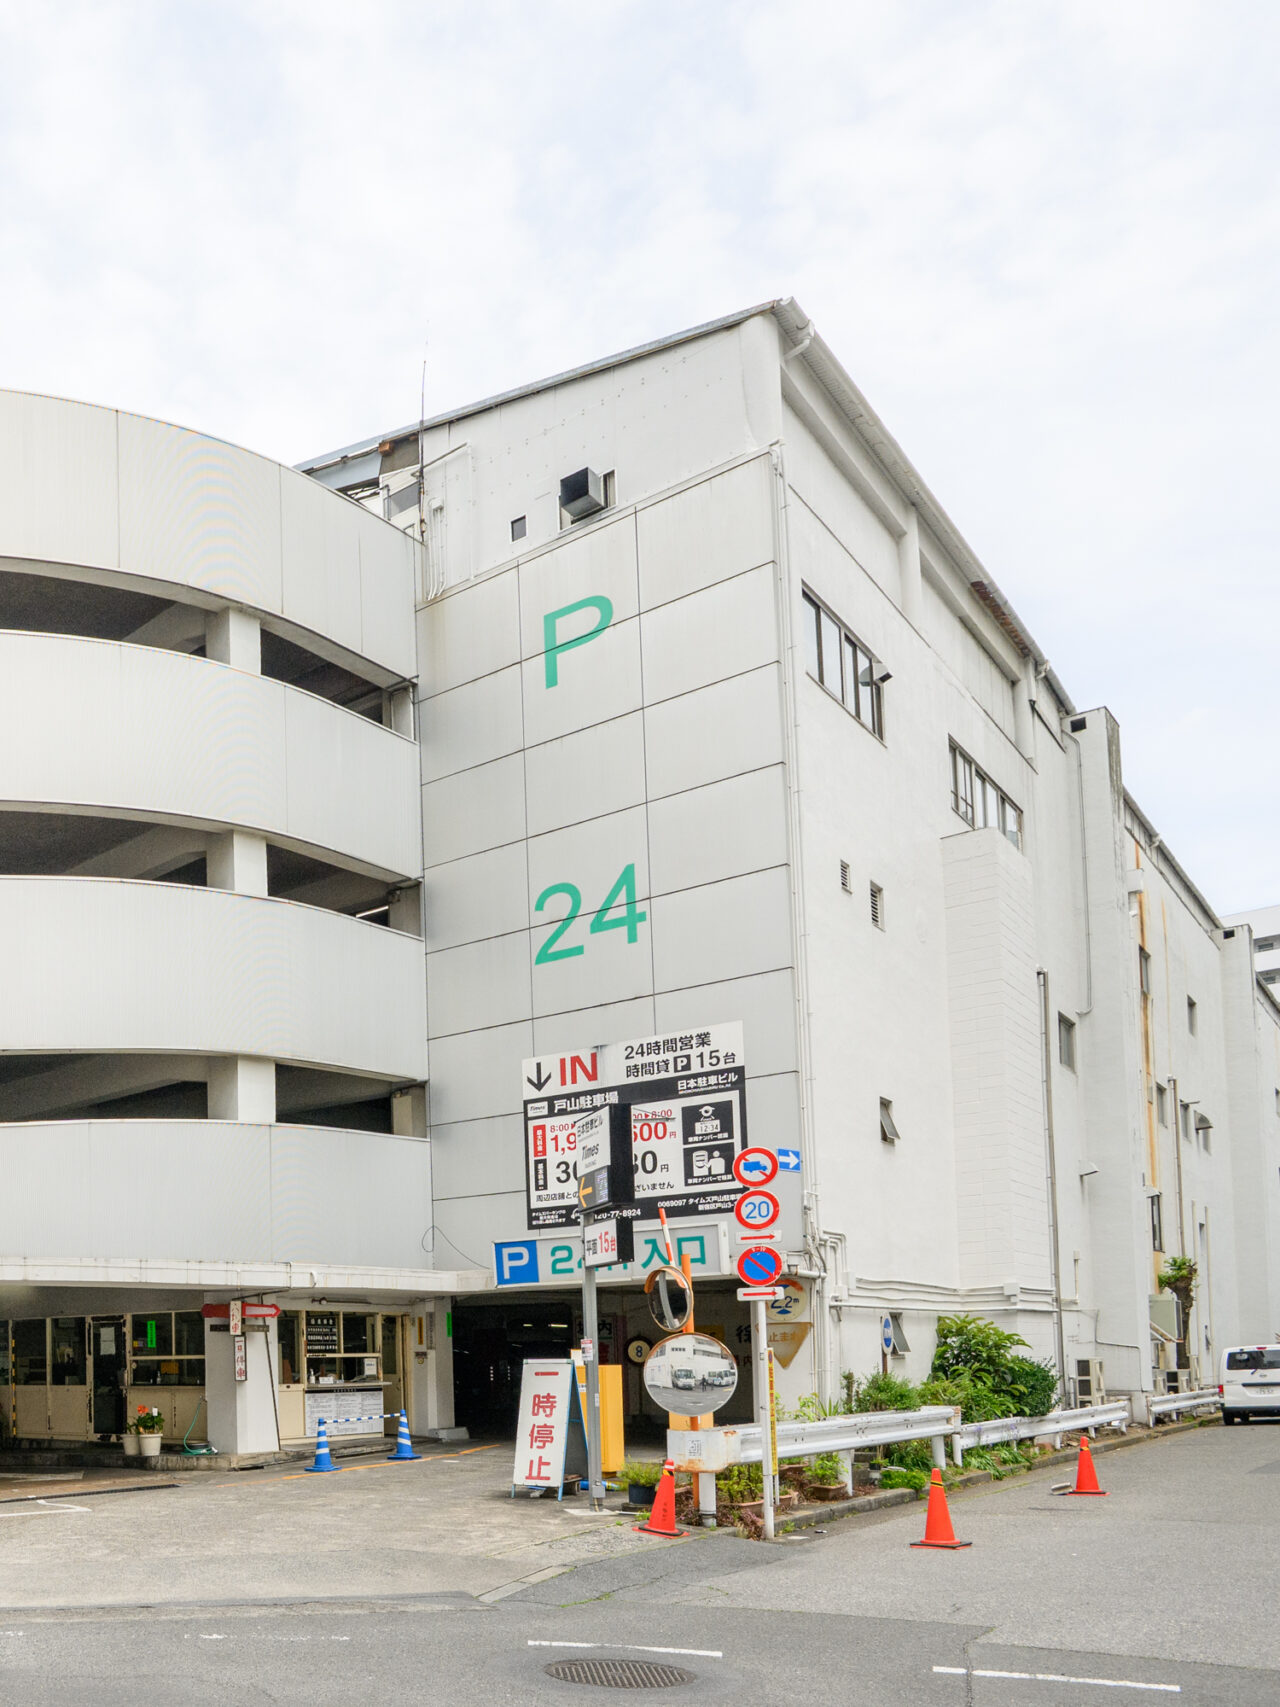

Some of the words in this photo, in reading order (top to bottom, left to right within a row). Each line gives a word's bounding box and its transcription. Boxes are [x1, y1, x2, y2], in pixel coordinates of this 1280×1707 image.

[543, 595, 614, 689] P
[534, 863, 647, 966] 24
[624, 1031, 712, 1061] 24時間営業
[559, 1052, 599, 1087] IN
[625, 1059, 670, 1079] 時間貸
[695, 1050, 736, 1069] 15台
[677, 1072, 739, 1091] 日本駐車ビル
[553, 1091, 619, 1113] 戸山駐車場
[549, 1123, 569, 1133] 8:00
[550, 1132, 577, 1156] 1,9
[581, 1143, 600, 1161] Times
[744, 1201, 770, 1220] 20
[502, 1246, 530, 1280] P
[635, 1344, 644, 1357] 8
[525, 1371, 560, 1482] 一時停止
